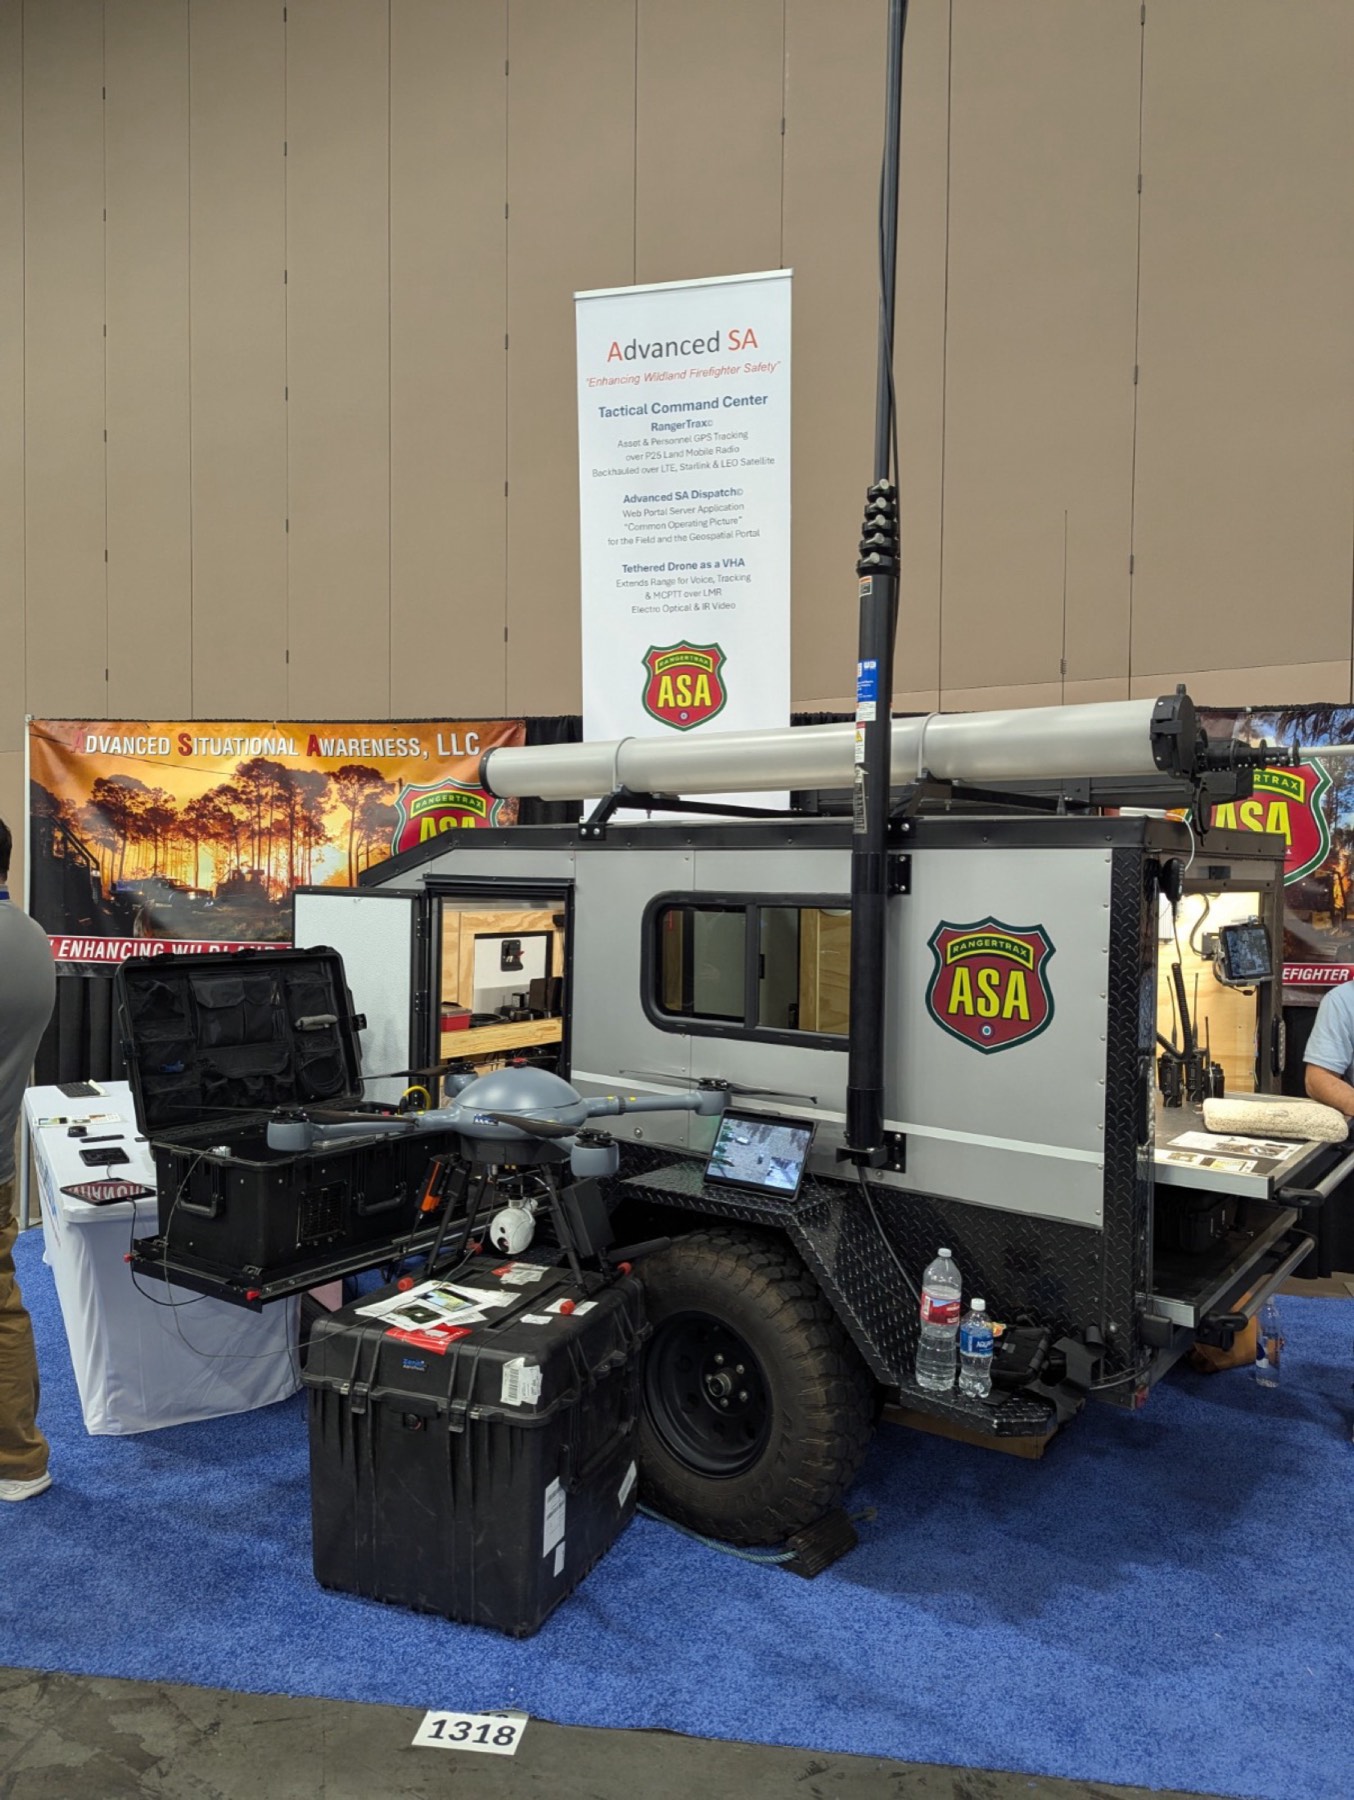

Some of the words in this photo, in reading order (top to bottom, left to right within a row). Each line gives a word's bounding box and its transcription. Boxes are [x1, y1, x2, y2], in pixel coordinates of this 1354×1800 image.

[607, 331, 720, 362] Advanced
[728, 328, 758, 351] SA
[644, 369, 686, 383] Wildland
[689, 365, 740, 379] Firefighter
[598, 404, 648, 418] Tactical
[651, 398, 719, 414] Command
[723, 394, 768, 408] Center
[617, 439, 641, 448] Asset
[643, 438, 649, 446] &
[651, 435, 692, 445] Personnel
[694, 433, 713, 441] GPS
[714, 430, 749, 440] Tracking
[625, 453, 644, 462] over
[646, 451, 662, 460] P25
[663, 449, 684, 458] Land
[686, 446, 714, 456] Mobile
[716, 445, 740, 453] Radio
[592, 466, 640, 477] Backhauled
[641, 464, 660, 473] over
[661, 462, 679, 472] LTE,
[680, 459, 711, 470] Starlink
[713, 459, 719, 468] &
[721, 457, 739, 467] LEO
[740, 454, 776, 465] Satellite
[623, 491, 673, 503] Advanced
[675, 489, 690, 500] SA
[622, 508, 642, 518] Web
[644, 505, 668, 516] Portal
[670, 504, 696, 514] Server
[698, 501, 745, 513] Application
[668, 517, 709, 529] Operating
[608, 537, 619, 546] for
[620, 536, 634, 545] the
[636, 534, 656, 545] Field
[657, 533, 673, 543] and
[674, 532, 688, 542] the
[689, 530, 734, 542] Geospatial
[735, 526, 761, 537] Portal
[622, 562, 666, 573] Tethered
[667, 559, 698, 571] Drone
[699, 559, 713, 569] as
[714, 559, 721, 568] a
[722, 556, 746, 567] VHA
[616, 578, 649, 588] Extends
[650, 575, 677, 587] Range
[677, 576, 690, 586] for
[690, 574, 716, 584] Voice,
[717, 571, 752, 583] Tracking
[645, 591, 652, 600] &
[653, 589, 683, 599] MCPTT
[683, 590, 702, 598] over
[703, 587, 723, 597] LMR
[631, 604, 662, 614] Electro
[662, 602, 693, 613] Optical
[693, 602, 700, 611] &
[701, 601, 711, 610] IR
[712, 600, 737, 610] Video
[657, 673, 712, 708] ASA
[177, 732, 299, 757] SITUATIONAL
[306, 734, 430, 760] AWARENESS,
[436, 731, 481, 757] LLC
[1253, 774, 1299, 791] RTRAX
[415, 794, 483, 809] RANGERTRAX
[952, 938, 1028, 958] RANGERTRAX
[1282, 967, 1350, 981] EFIGHTER
[947, 966, 1031, 1021] ASA
[427, 1719, 517, 1746] 1318
